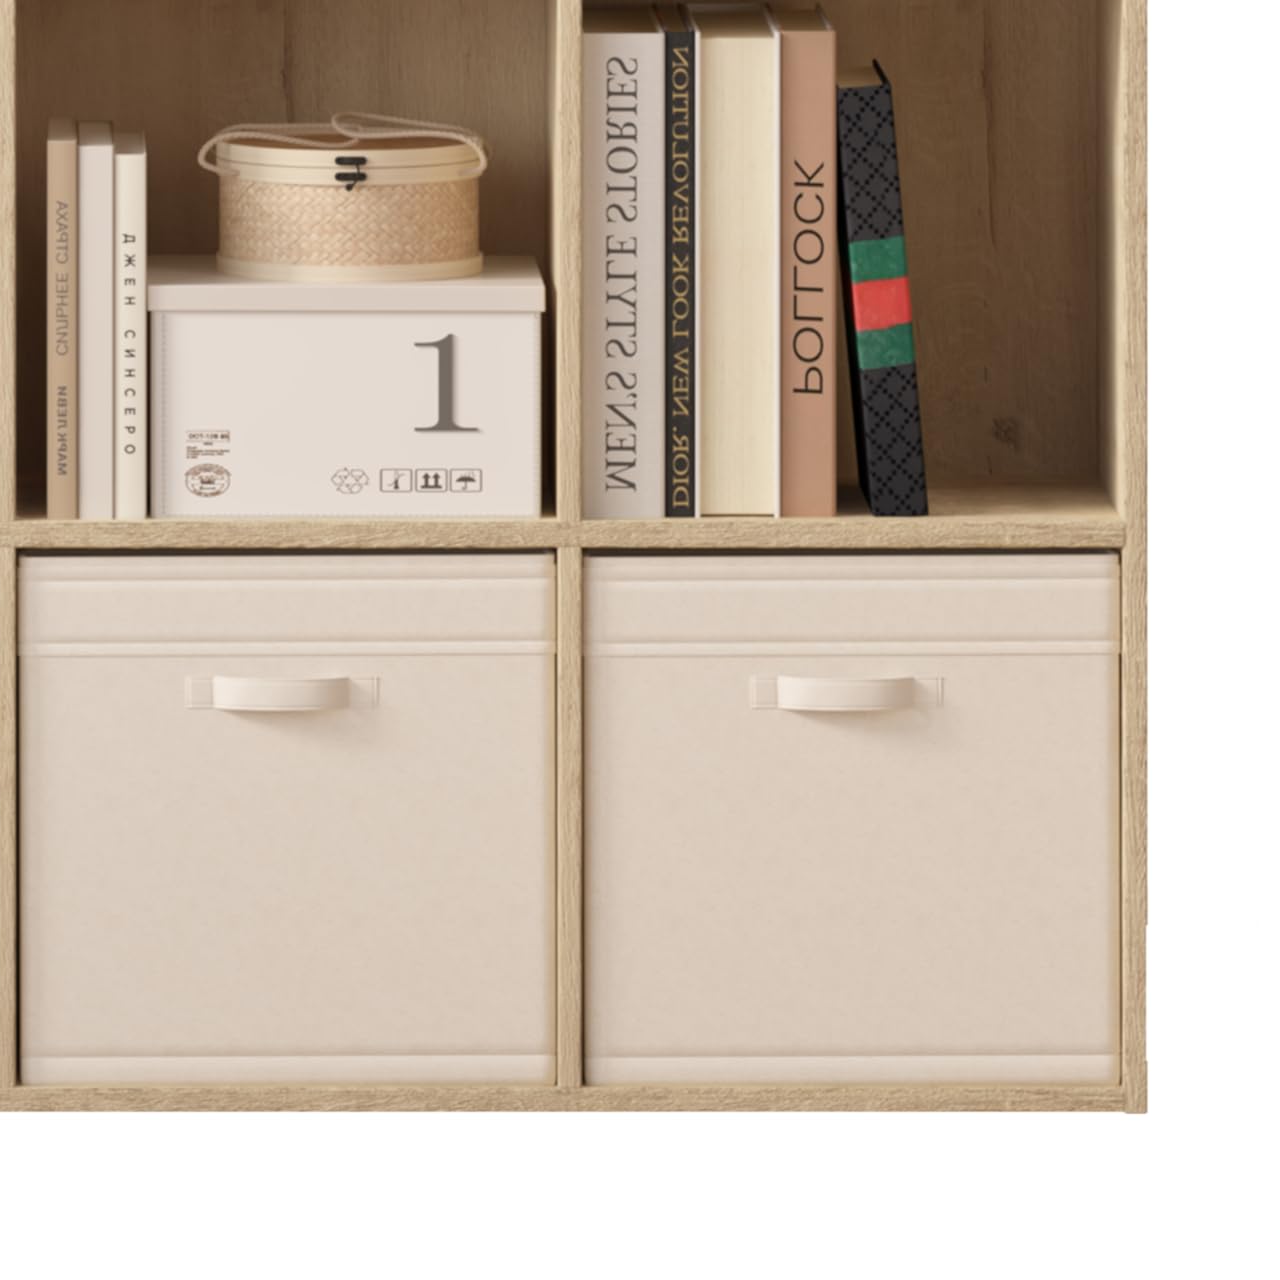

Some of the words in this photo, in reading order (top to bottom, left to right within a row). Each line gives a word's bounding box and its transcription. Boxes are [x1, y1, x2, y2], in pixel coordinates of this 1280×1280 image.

[122, 232, 137, 306] ДЖЕН
[124, 329, 137, 455] СИНСЕРО
[413, 332, 482, 433] 1
